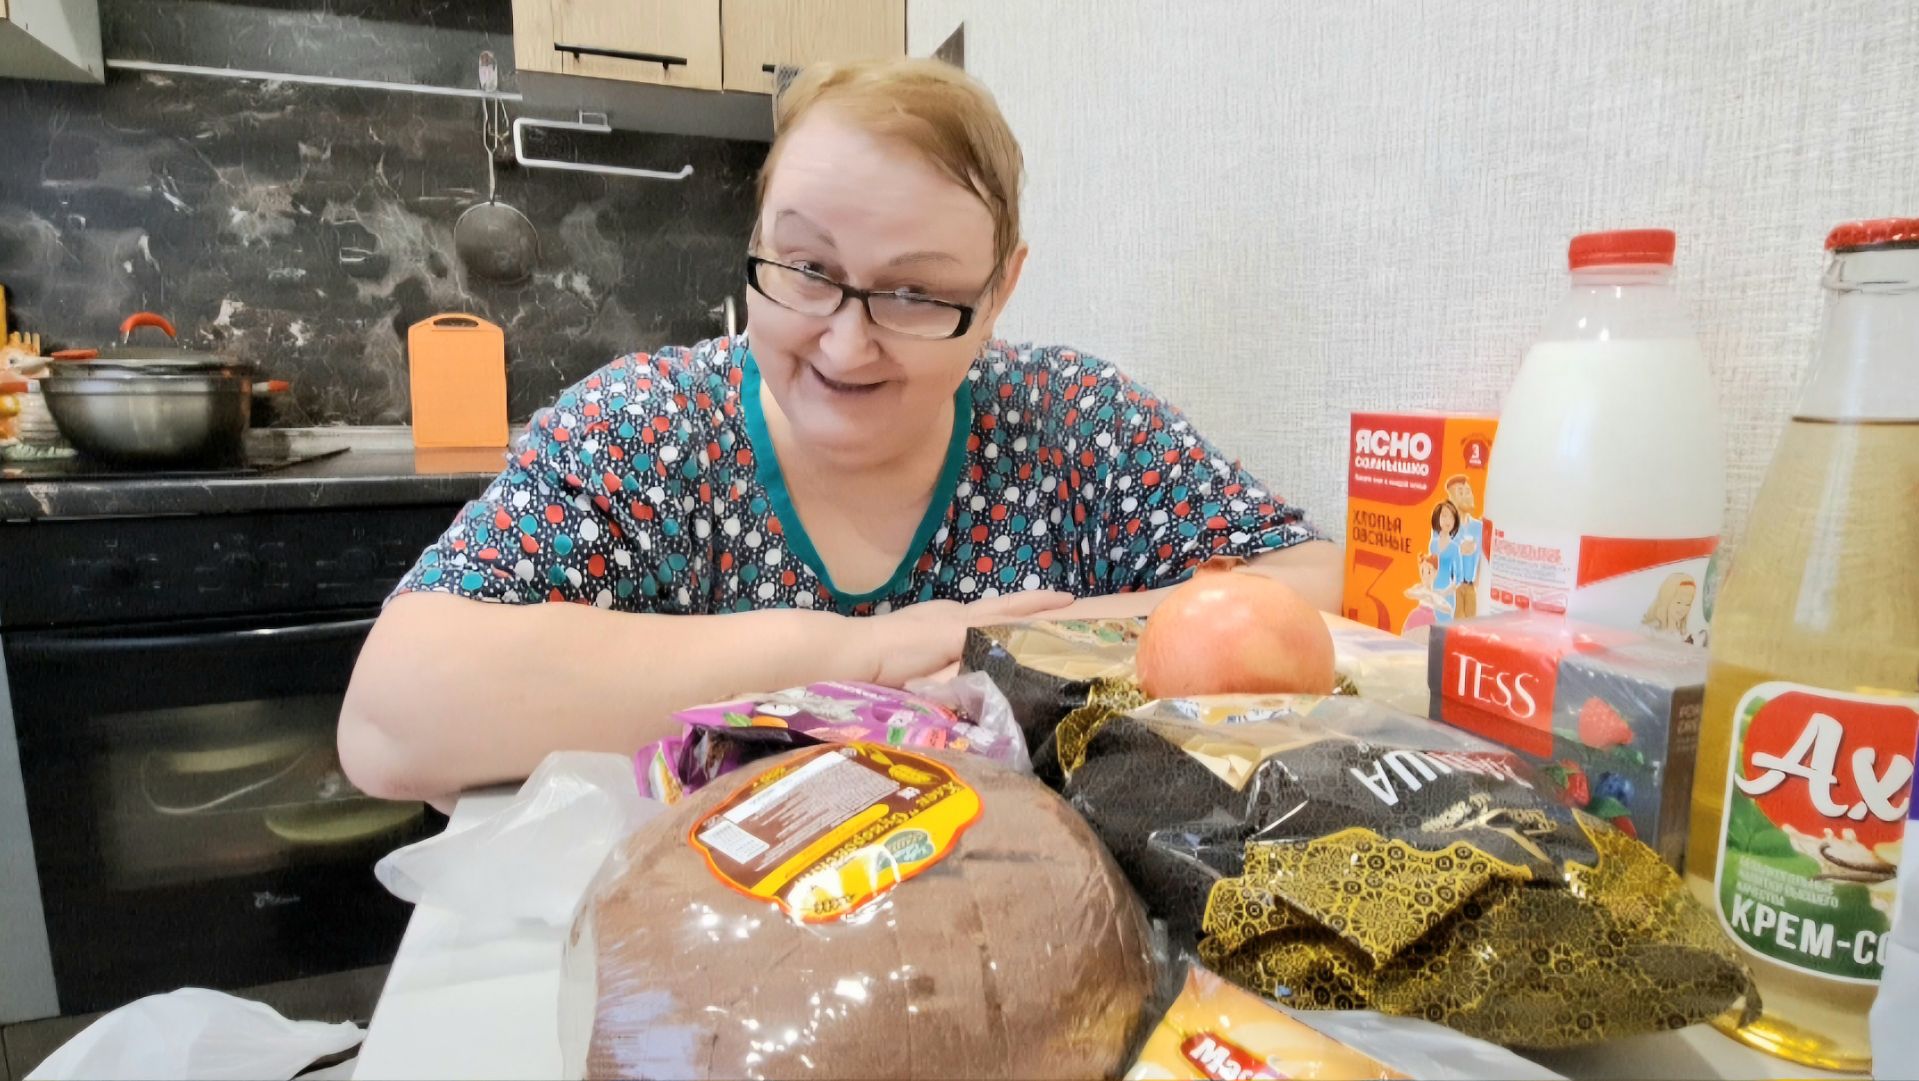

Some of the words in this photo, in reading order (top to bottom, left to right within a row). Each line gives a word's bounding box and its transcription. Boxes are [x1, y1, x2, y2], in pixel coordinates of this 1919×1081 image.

[1355, 429, 1432, 461] ЯСНО
[1472, 443, 1480, 459] 3
[1354, 455, 1430, 477] СОЛНЫШКО
[1352, 510, 1402, 534] ХЛОПЬЯ
[1352, 526, 1412, 554] ОВСЯНЫЕ
[1452, 651, 1537, 719] TESS
